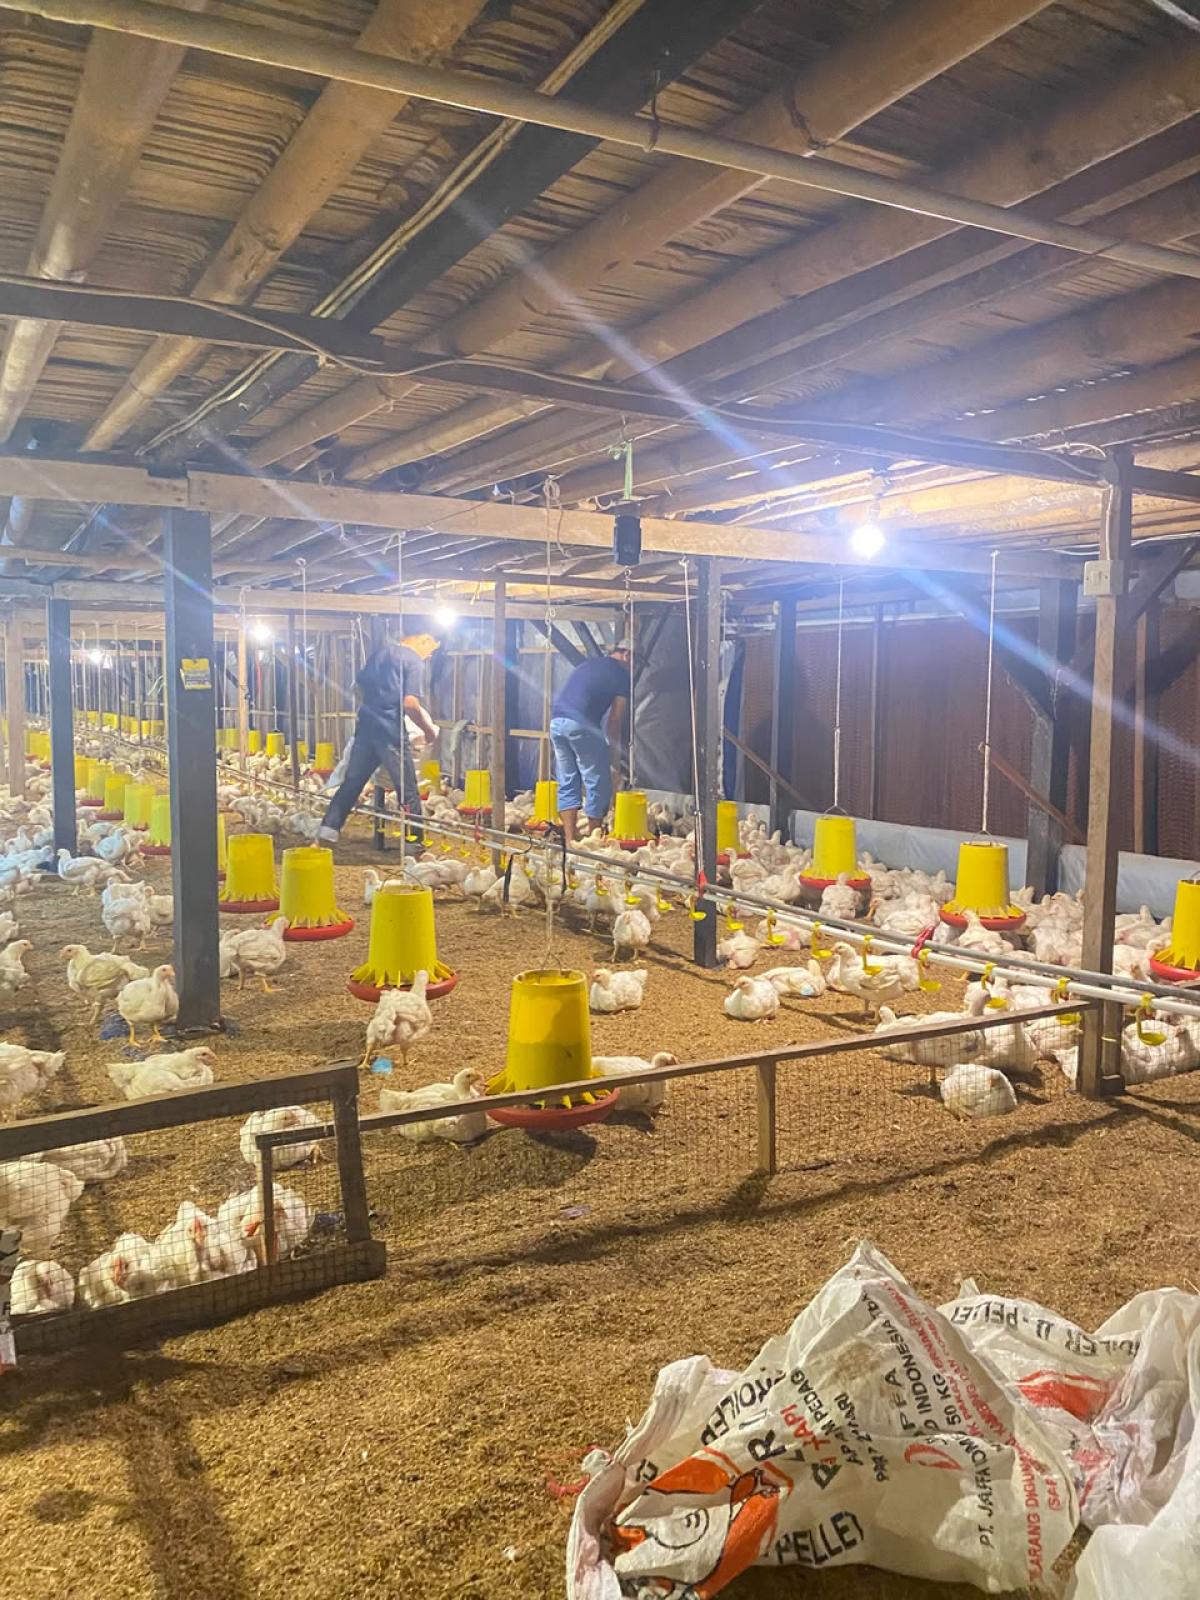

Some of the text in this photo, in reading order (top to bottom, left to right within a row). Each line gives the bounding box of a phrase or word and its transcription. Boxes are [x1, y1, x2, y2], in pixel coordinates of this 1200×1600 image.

[880, 1319, 934, 1416] INDONESIA
[932, 1373, 952, 1401] KG
[944, 1403, 962, 1426] 50
